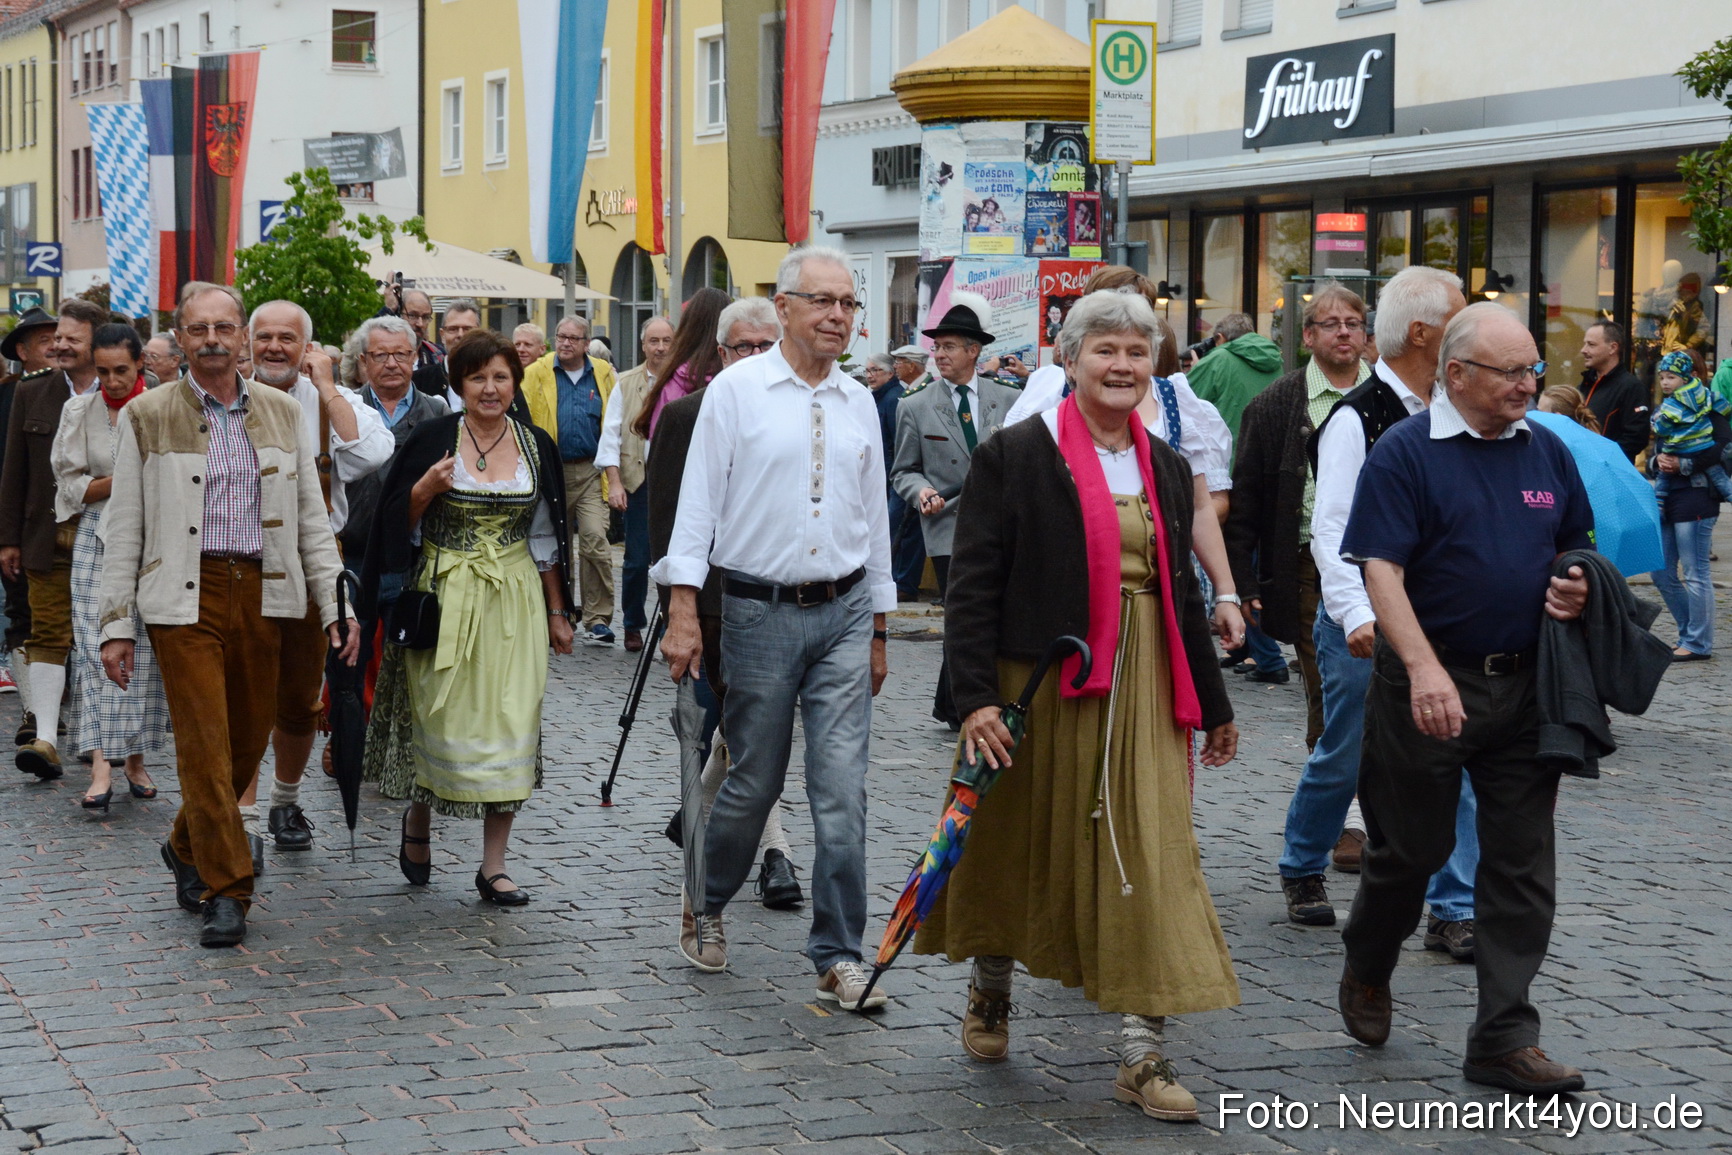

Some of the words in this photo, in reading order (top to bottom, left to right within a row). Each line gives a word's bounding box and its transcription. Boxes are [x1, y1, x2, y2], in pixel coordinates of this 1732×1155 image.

[1113, 43, 1135, 73] H
[1103, 91, 1144, 101] Marktplatz
[1244, 48, 1383, 139] frühauf
[968, 270, 988, 284] Open
[1521, 490, 1555, 505] KAB
